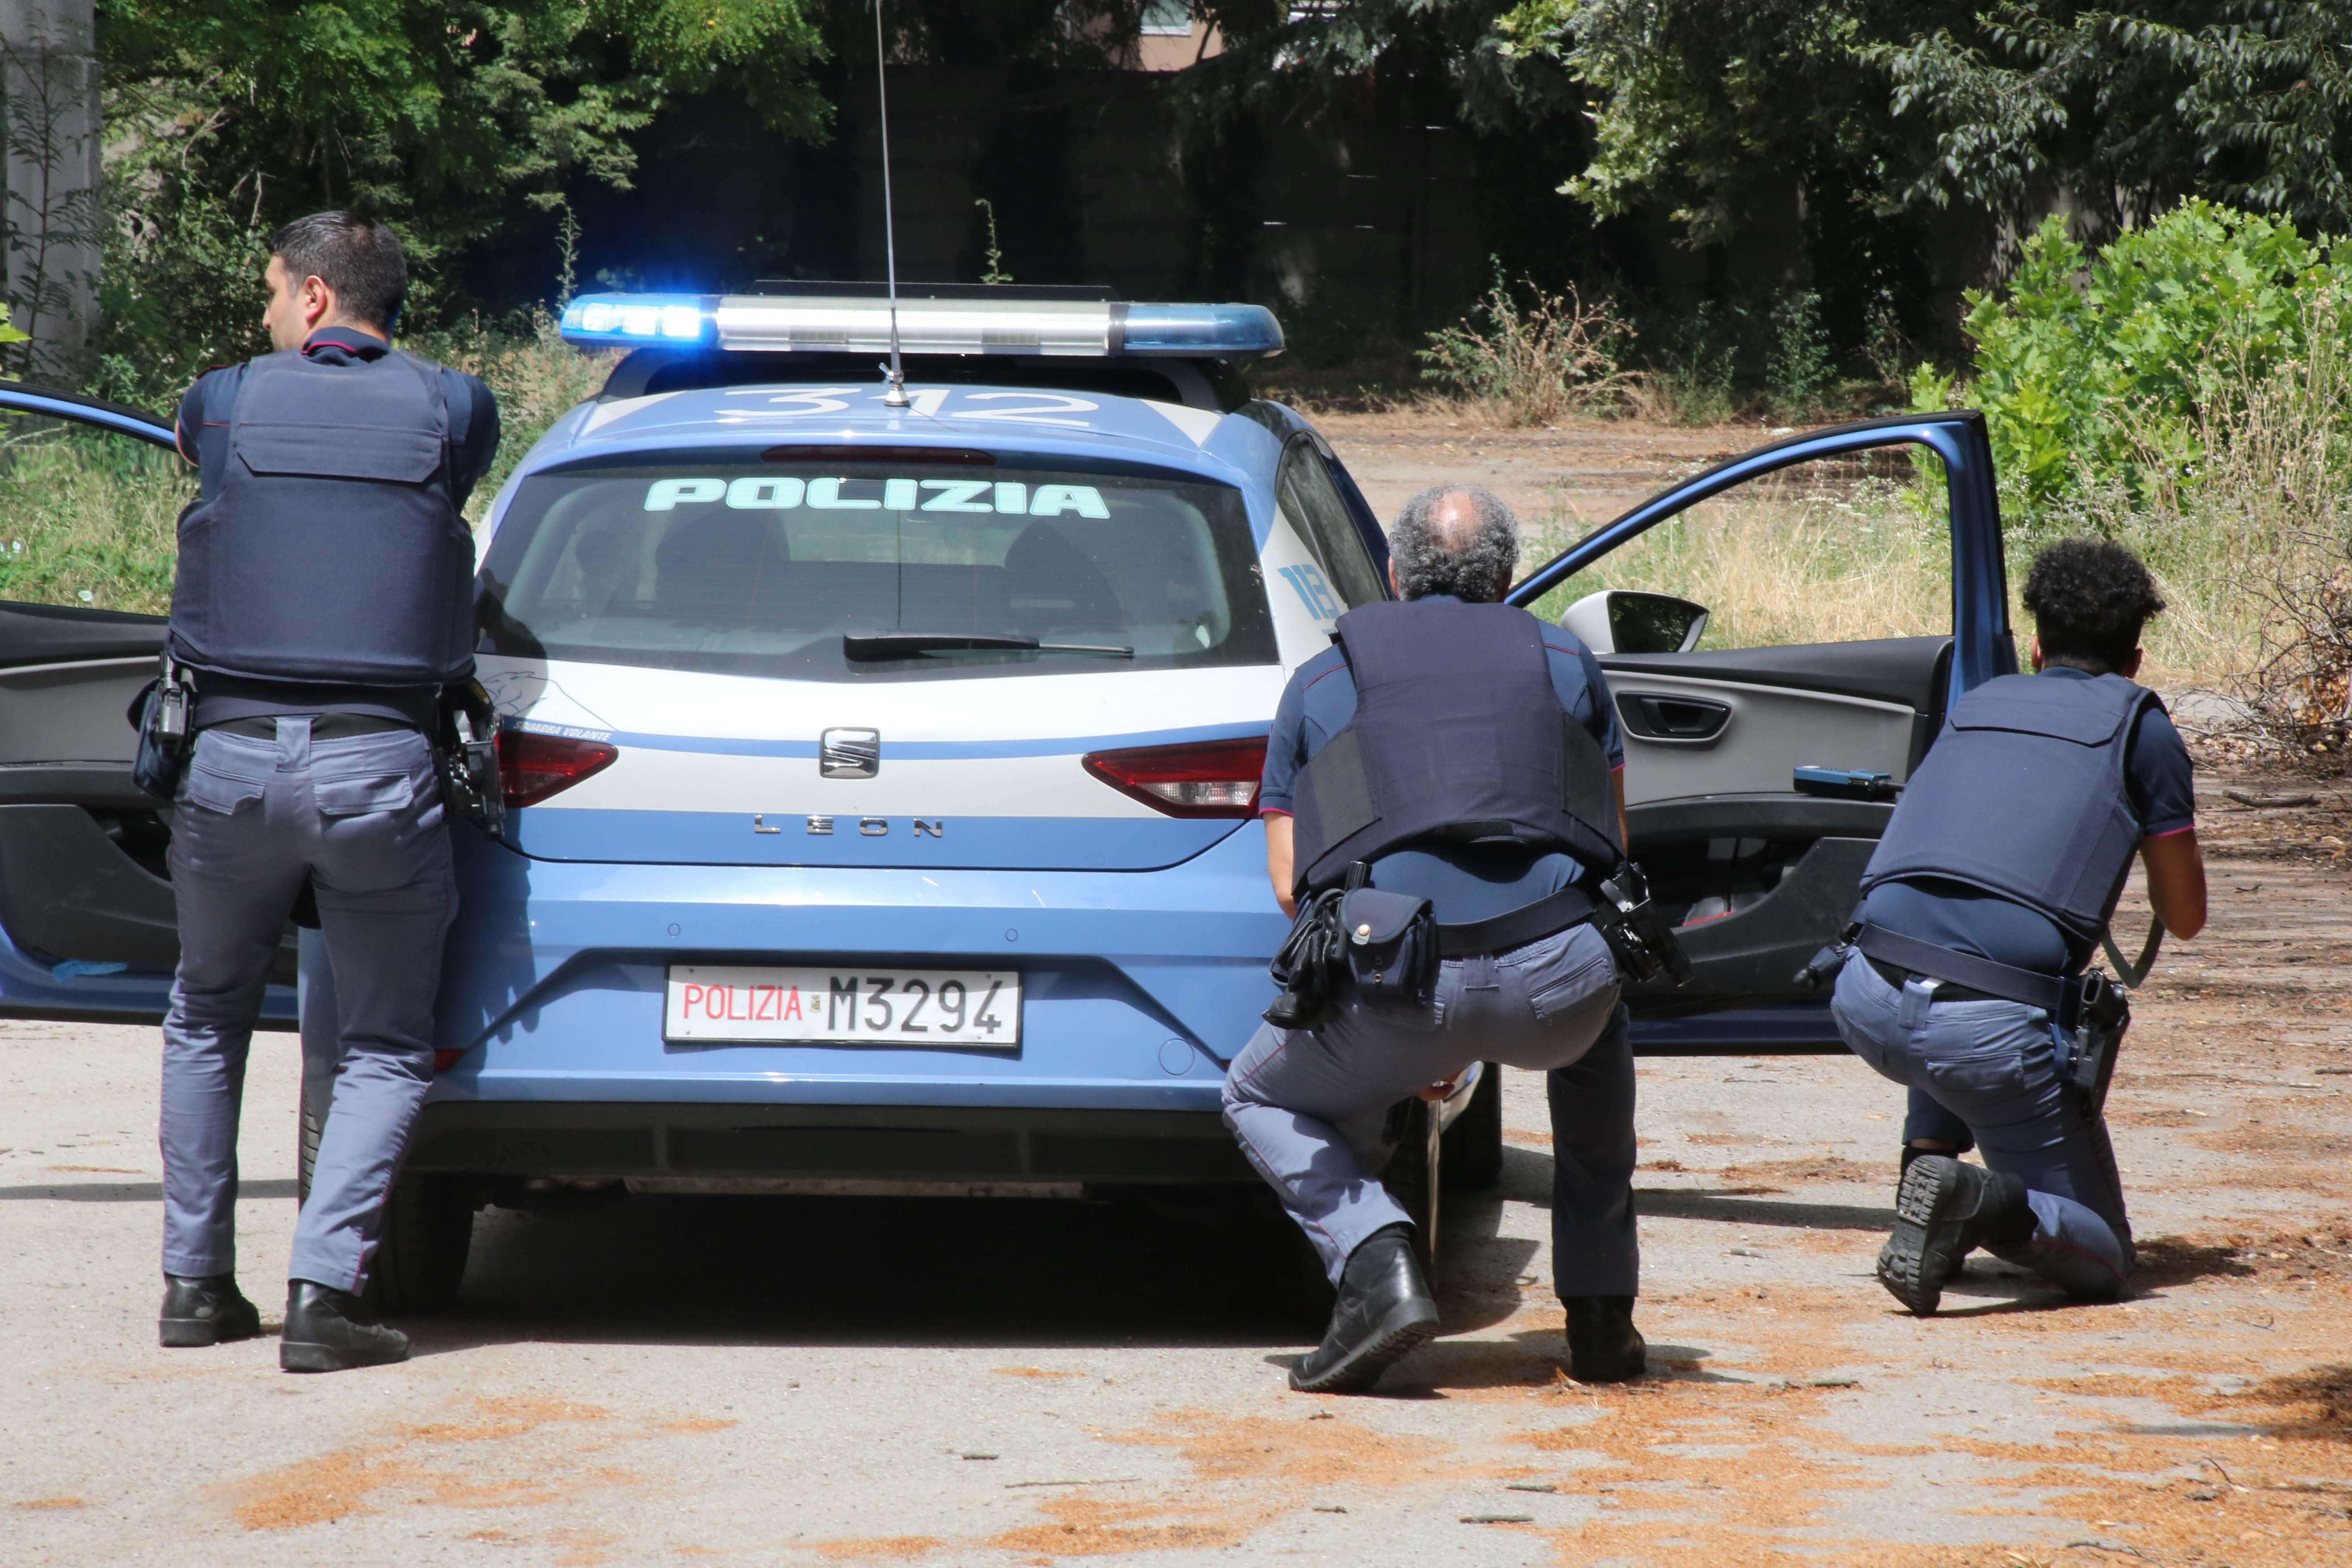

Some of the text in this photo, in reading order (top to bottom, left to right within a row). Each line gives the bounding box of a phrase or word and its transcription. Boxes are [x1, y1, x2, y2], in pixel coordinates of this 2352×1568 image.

[714, 388, 1099, 427] 312
[644, 476, 1112, 519] POLIZIA
[514, 720, 612, 741] SQUADRA VOLANTE
[754, 814, 943, 837] LEON
[684, 976, 1003, 1034] POLIZIA M3294
